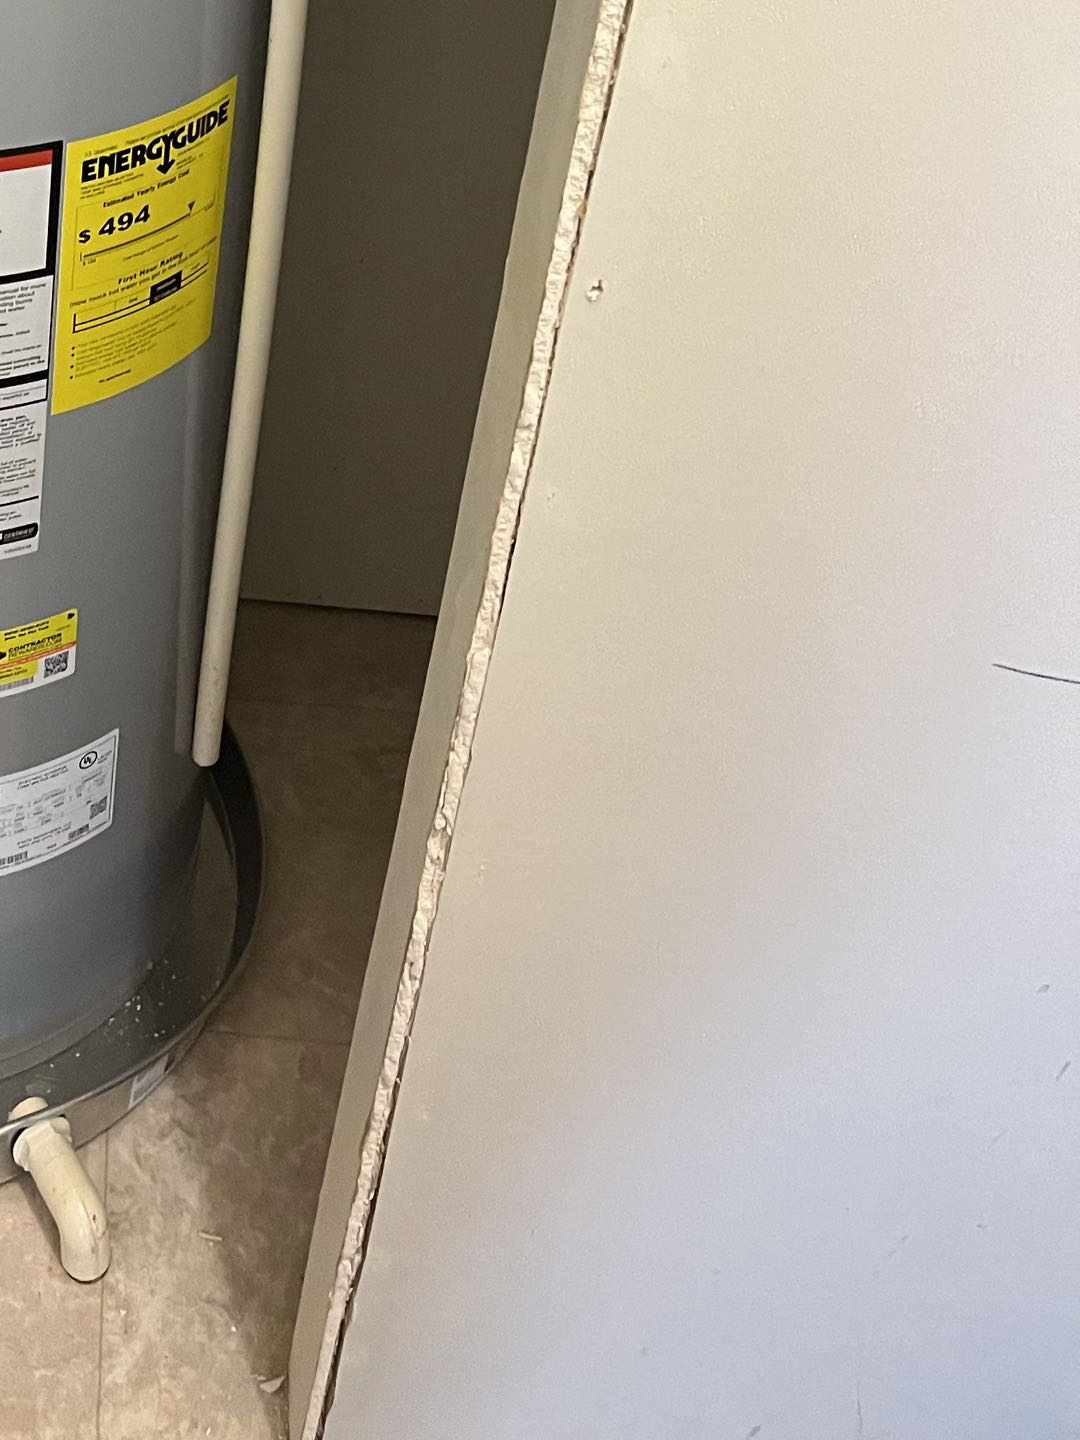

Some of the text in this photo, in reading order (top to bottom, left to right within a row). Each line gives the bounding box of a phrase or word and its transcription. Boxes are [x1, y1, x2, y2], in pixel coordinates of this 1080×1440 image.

[78, 204, 150, 244] $ 494
[118, 273, 137, 285] First
[139, 264, 158, 277] Hour
